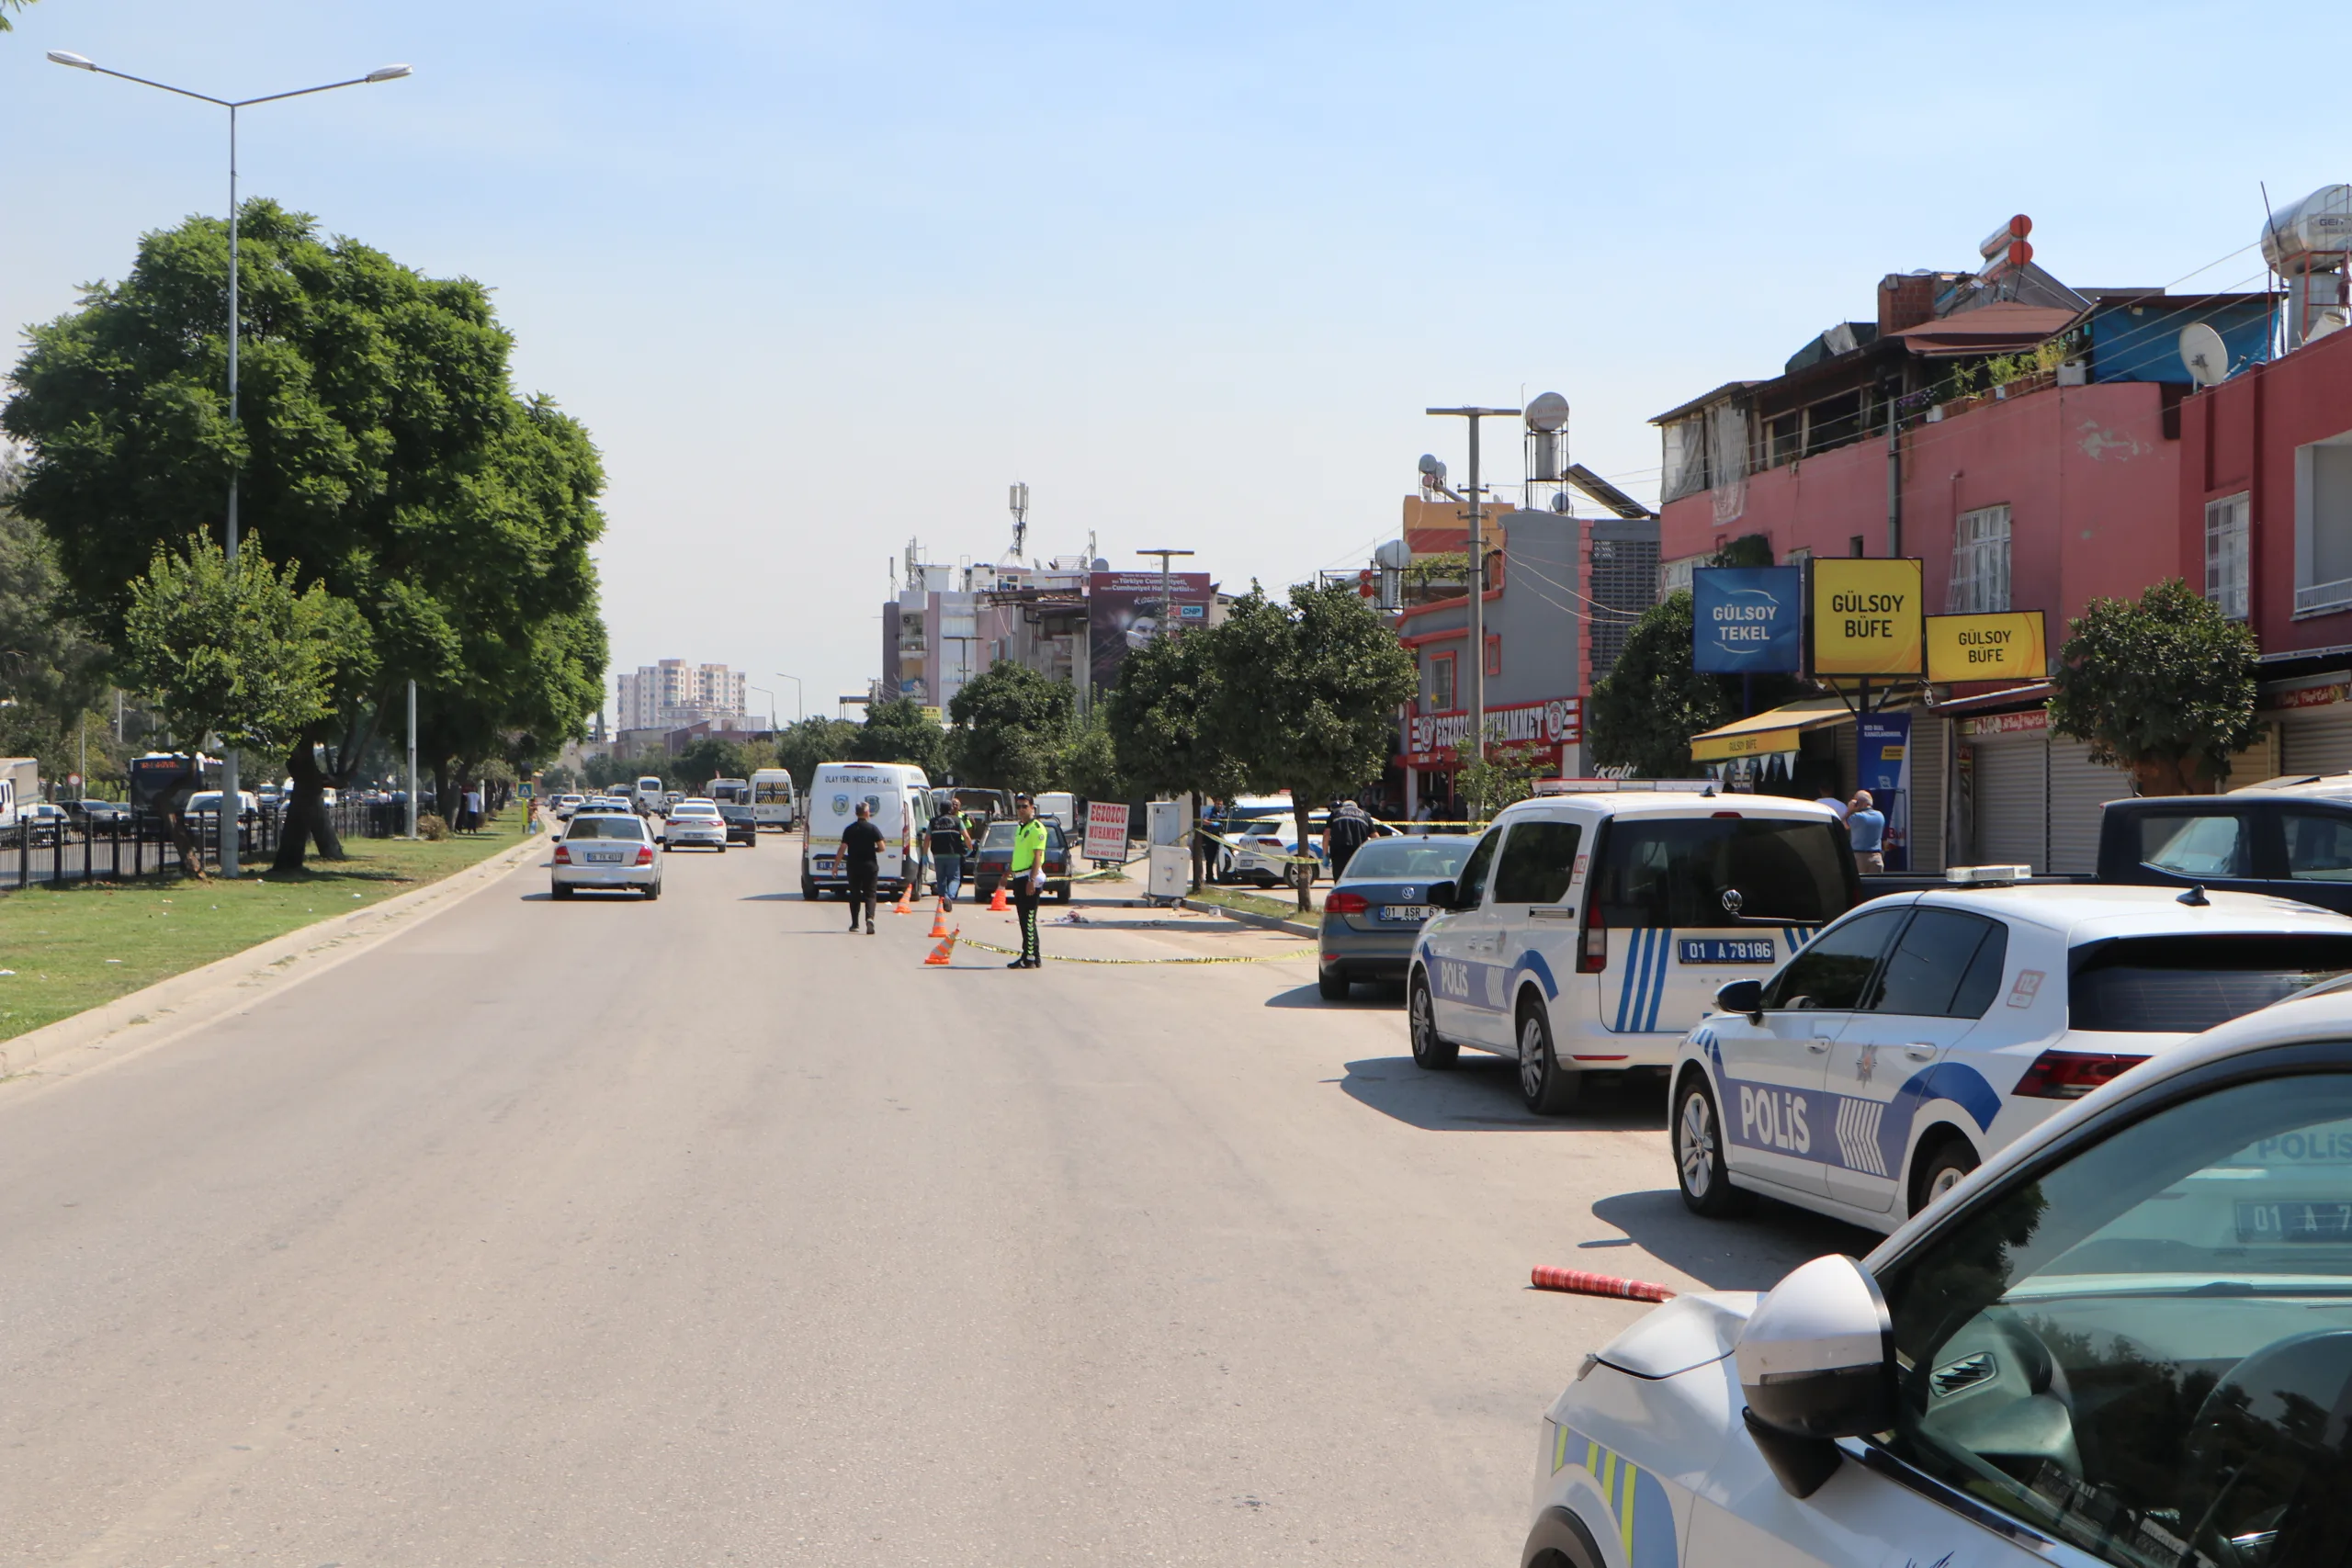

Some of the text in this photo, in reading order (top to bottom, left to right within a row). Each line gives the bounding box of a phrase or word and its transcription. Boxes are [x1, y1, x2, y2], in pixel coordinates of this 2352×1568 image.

[1145, 578, 1187, 586] Cumhriyeti,
[1832, 590, 1905, 613] GÜLSOY
[1182, 607, 1200, 615] CHP
[1713, 604, 1777, 621] GÜLSOY
[1719, 626, 1770, 640] TEKEL
[1845, 615, 1893, 637] BÜFE
[1958, 628, 2012, 646] GÜLSOY
[1968, 646, 2005, 663] BÜFE
[1091, 805, 1126, 823] EGZOZCU
[1089, 826, 1125, 840] MUHAMMET
[1385, 908, 1396, 917] 01
[1405, 907, 1420, 917] ASR
[1690, 942, 1771, 958] 01 A 78186
[2255, 1205, 2282, 1232] 01
[2304, 1205, 2317, 1232] A
